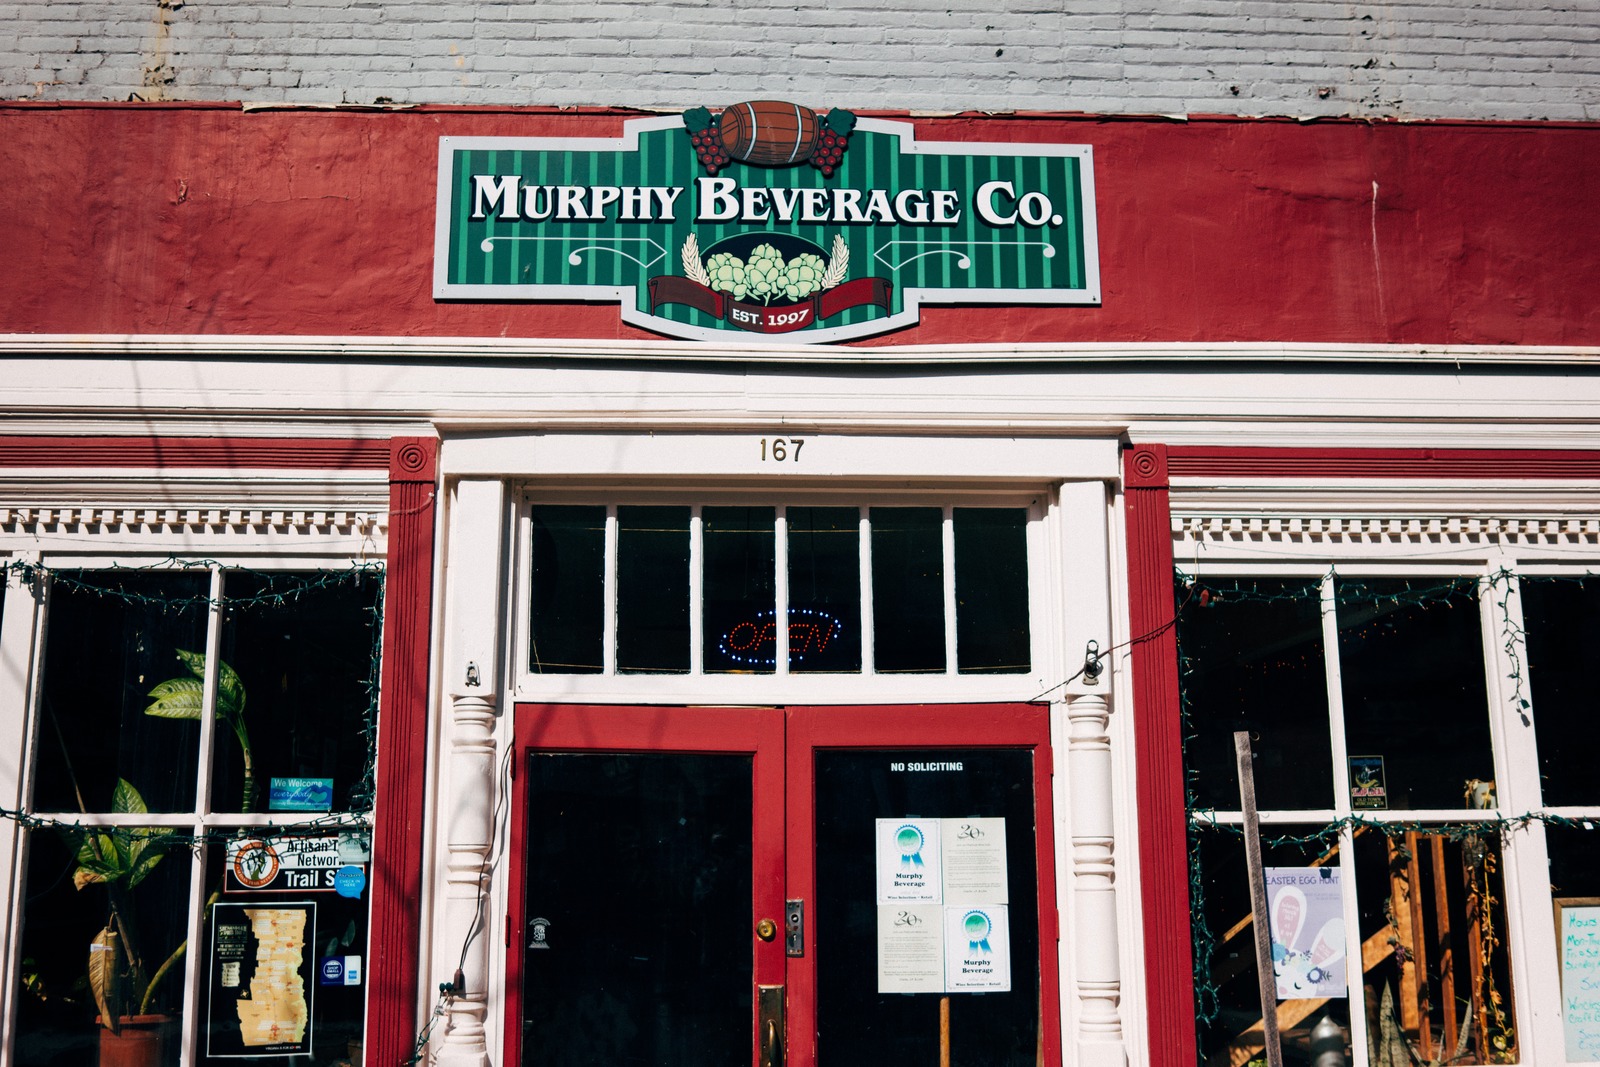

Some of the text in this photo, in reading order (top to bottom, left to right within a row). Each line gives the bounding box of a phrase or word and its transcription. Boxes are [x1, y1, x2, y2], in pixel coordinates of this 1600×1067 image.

[471, 174, 685, 221] MURPHY
[697, 176, 962, 224] BEVERAGE
[732, 308, 810, 326] EST. 1997
[760, 438, 805, 462] 167
[729, 622, 834, 652] OPEN
[890, 761, 963, 772] NO SOLICITING
[274, 779, 323, 788] We Welcome
[286, 839, 328, 852] Artisan
[285, 870, 319, 887] Trail
[1265, 876, 1296, 885] EASTER
[1299, 876, 1317, 885] EGG
